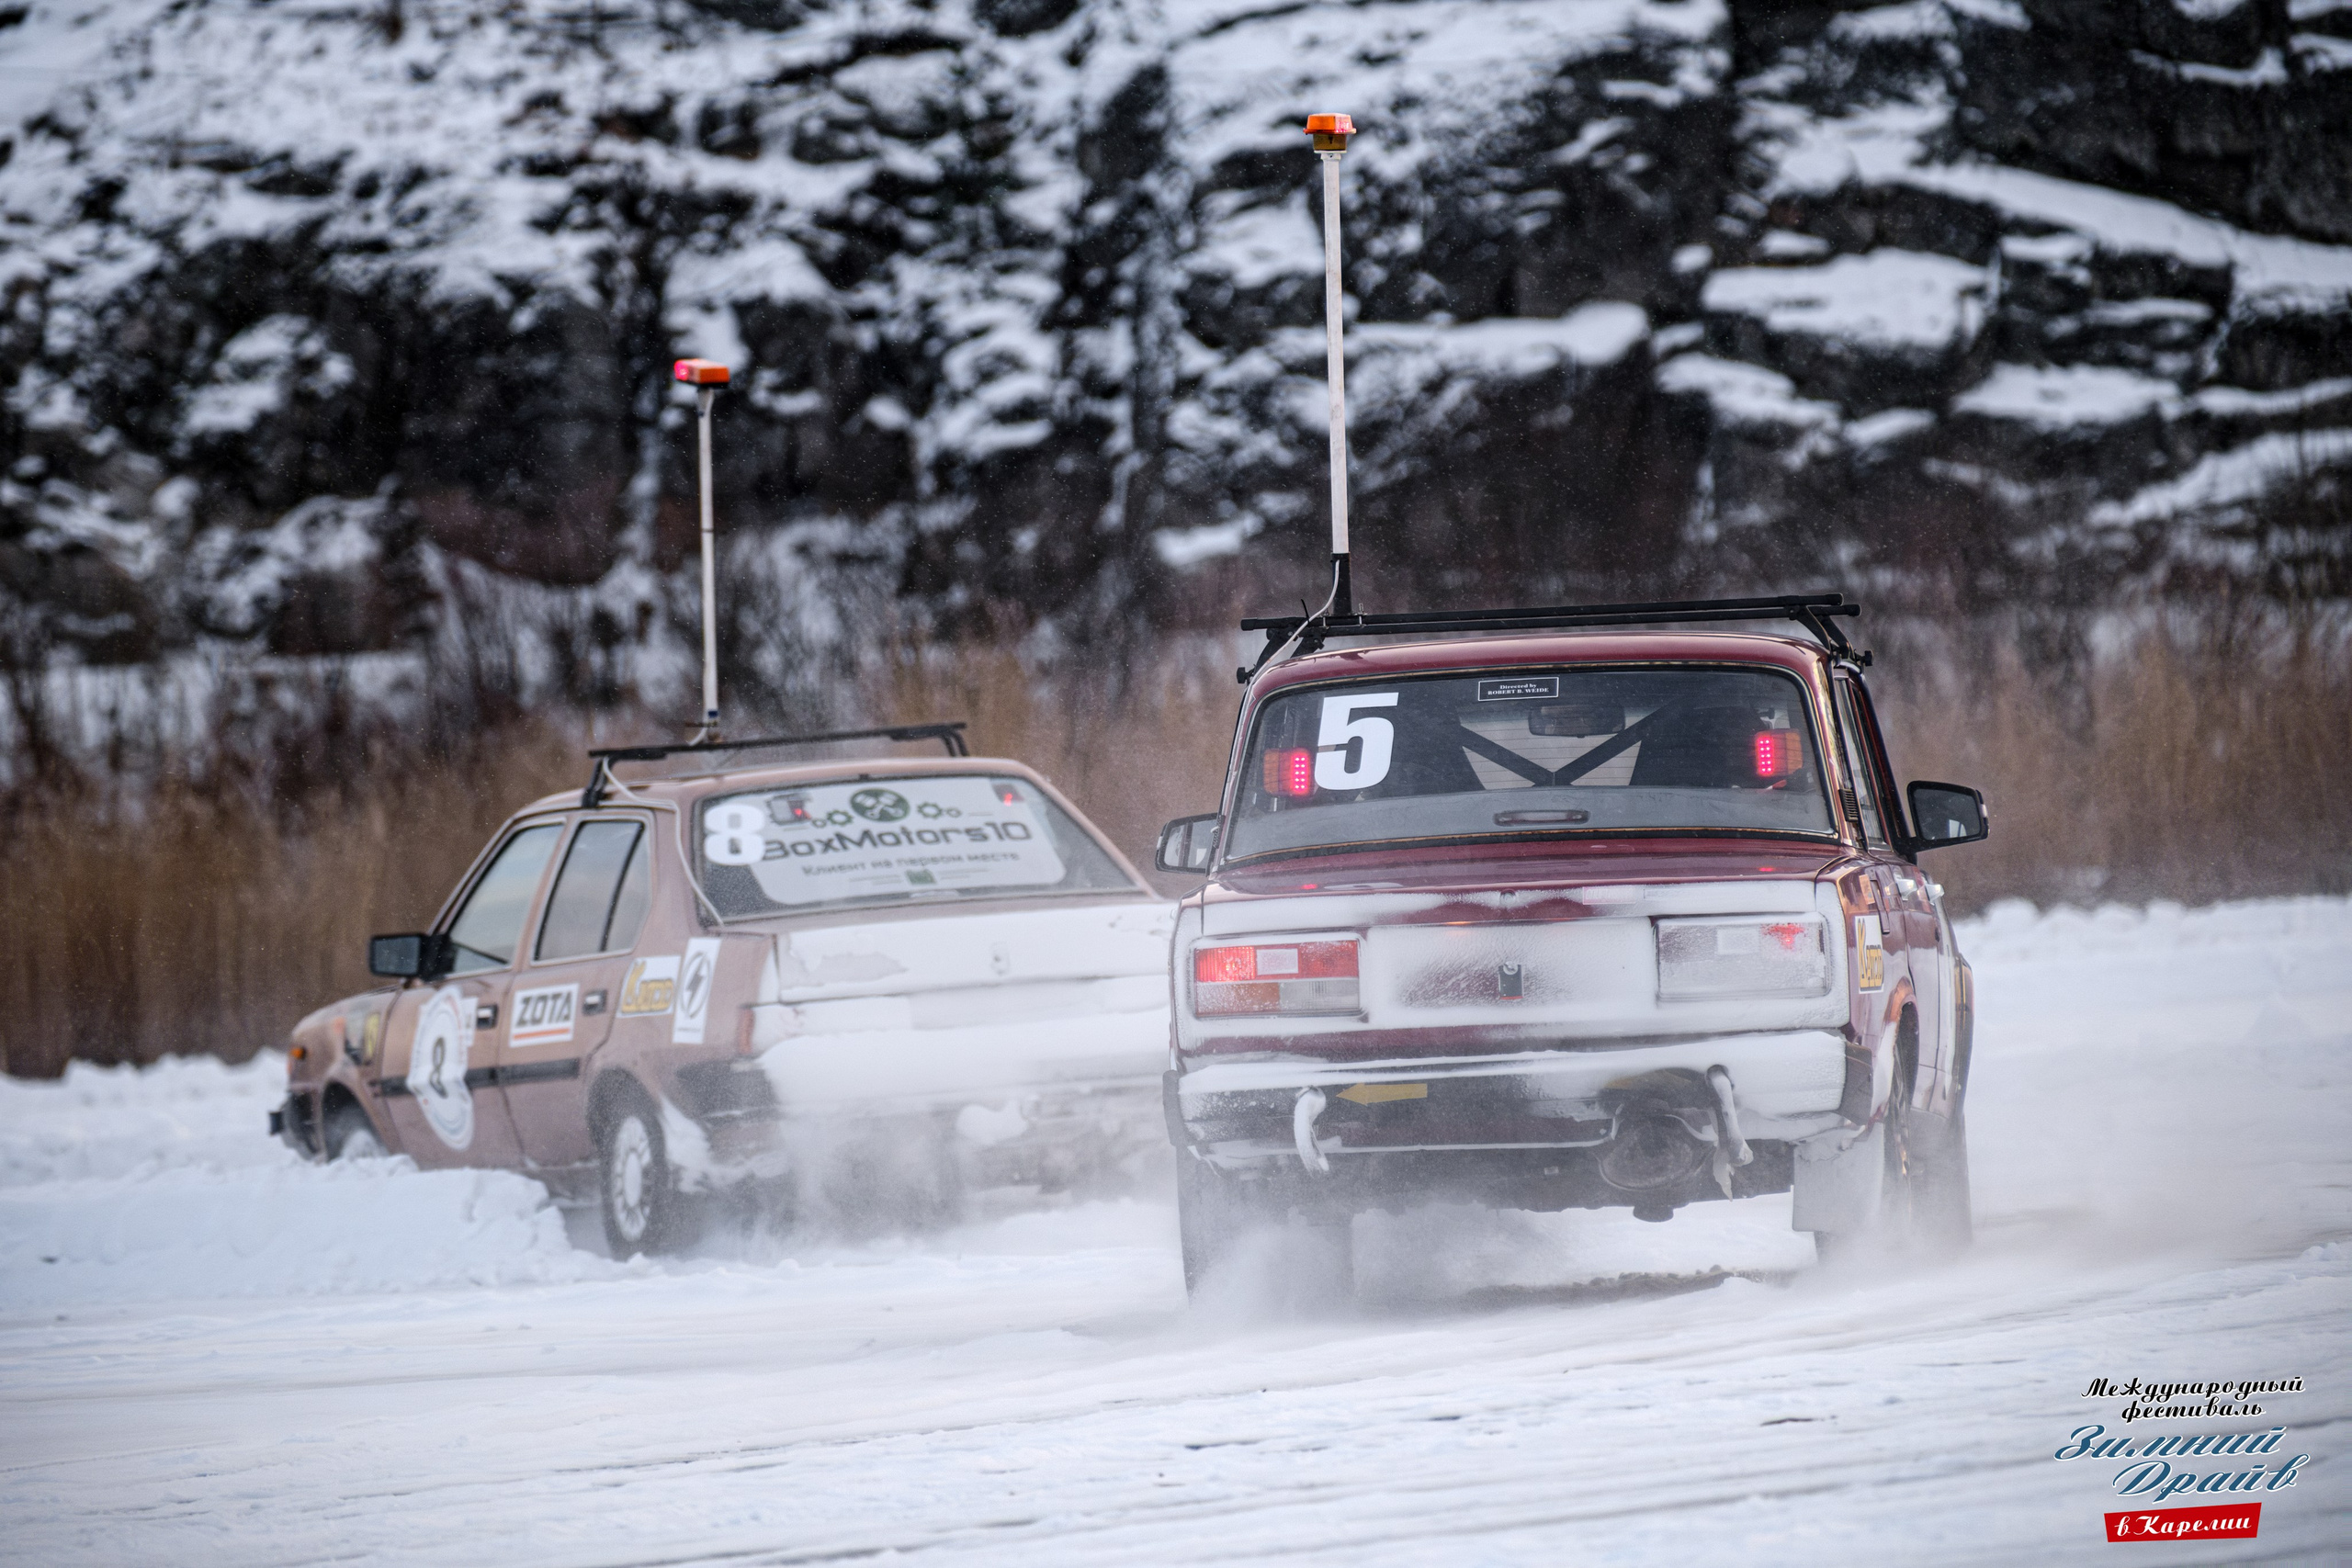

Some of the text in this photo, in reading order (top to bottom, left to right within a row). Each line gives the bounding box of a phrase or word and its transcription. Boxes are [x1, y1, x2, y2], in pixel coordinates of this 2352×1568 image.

[1314, 692, 1399, 790] 5
[704, 803, 766, 865] 8
[762, 821, 1032, 861] BoxMotors10
[515, 991, 571, 1028] ZOTA
[429, 1036, 449, 1100] 8
